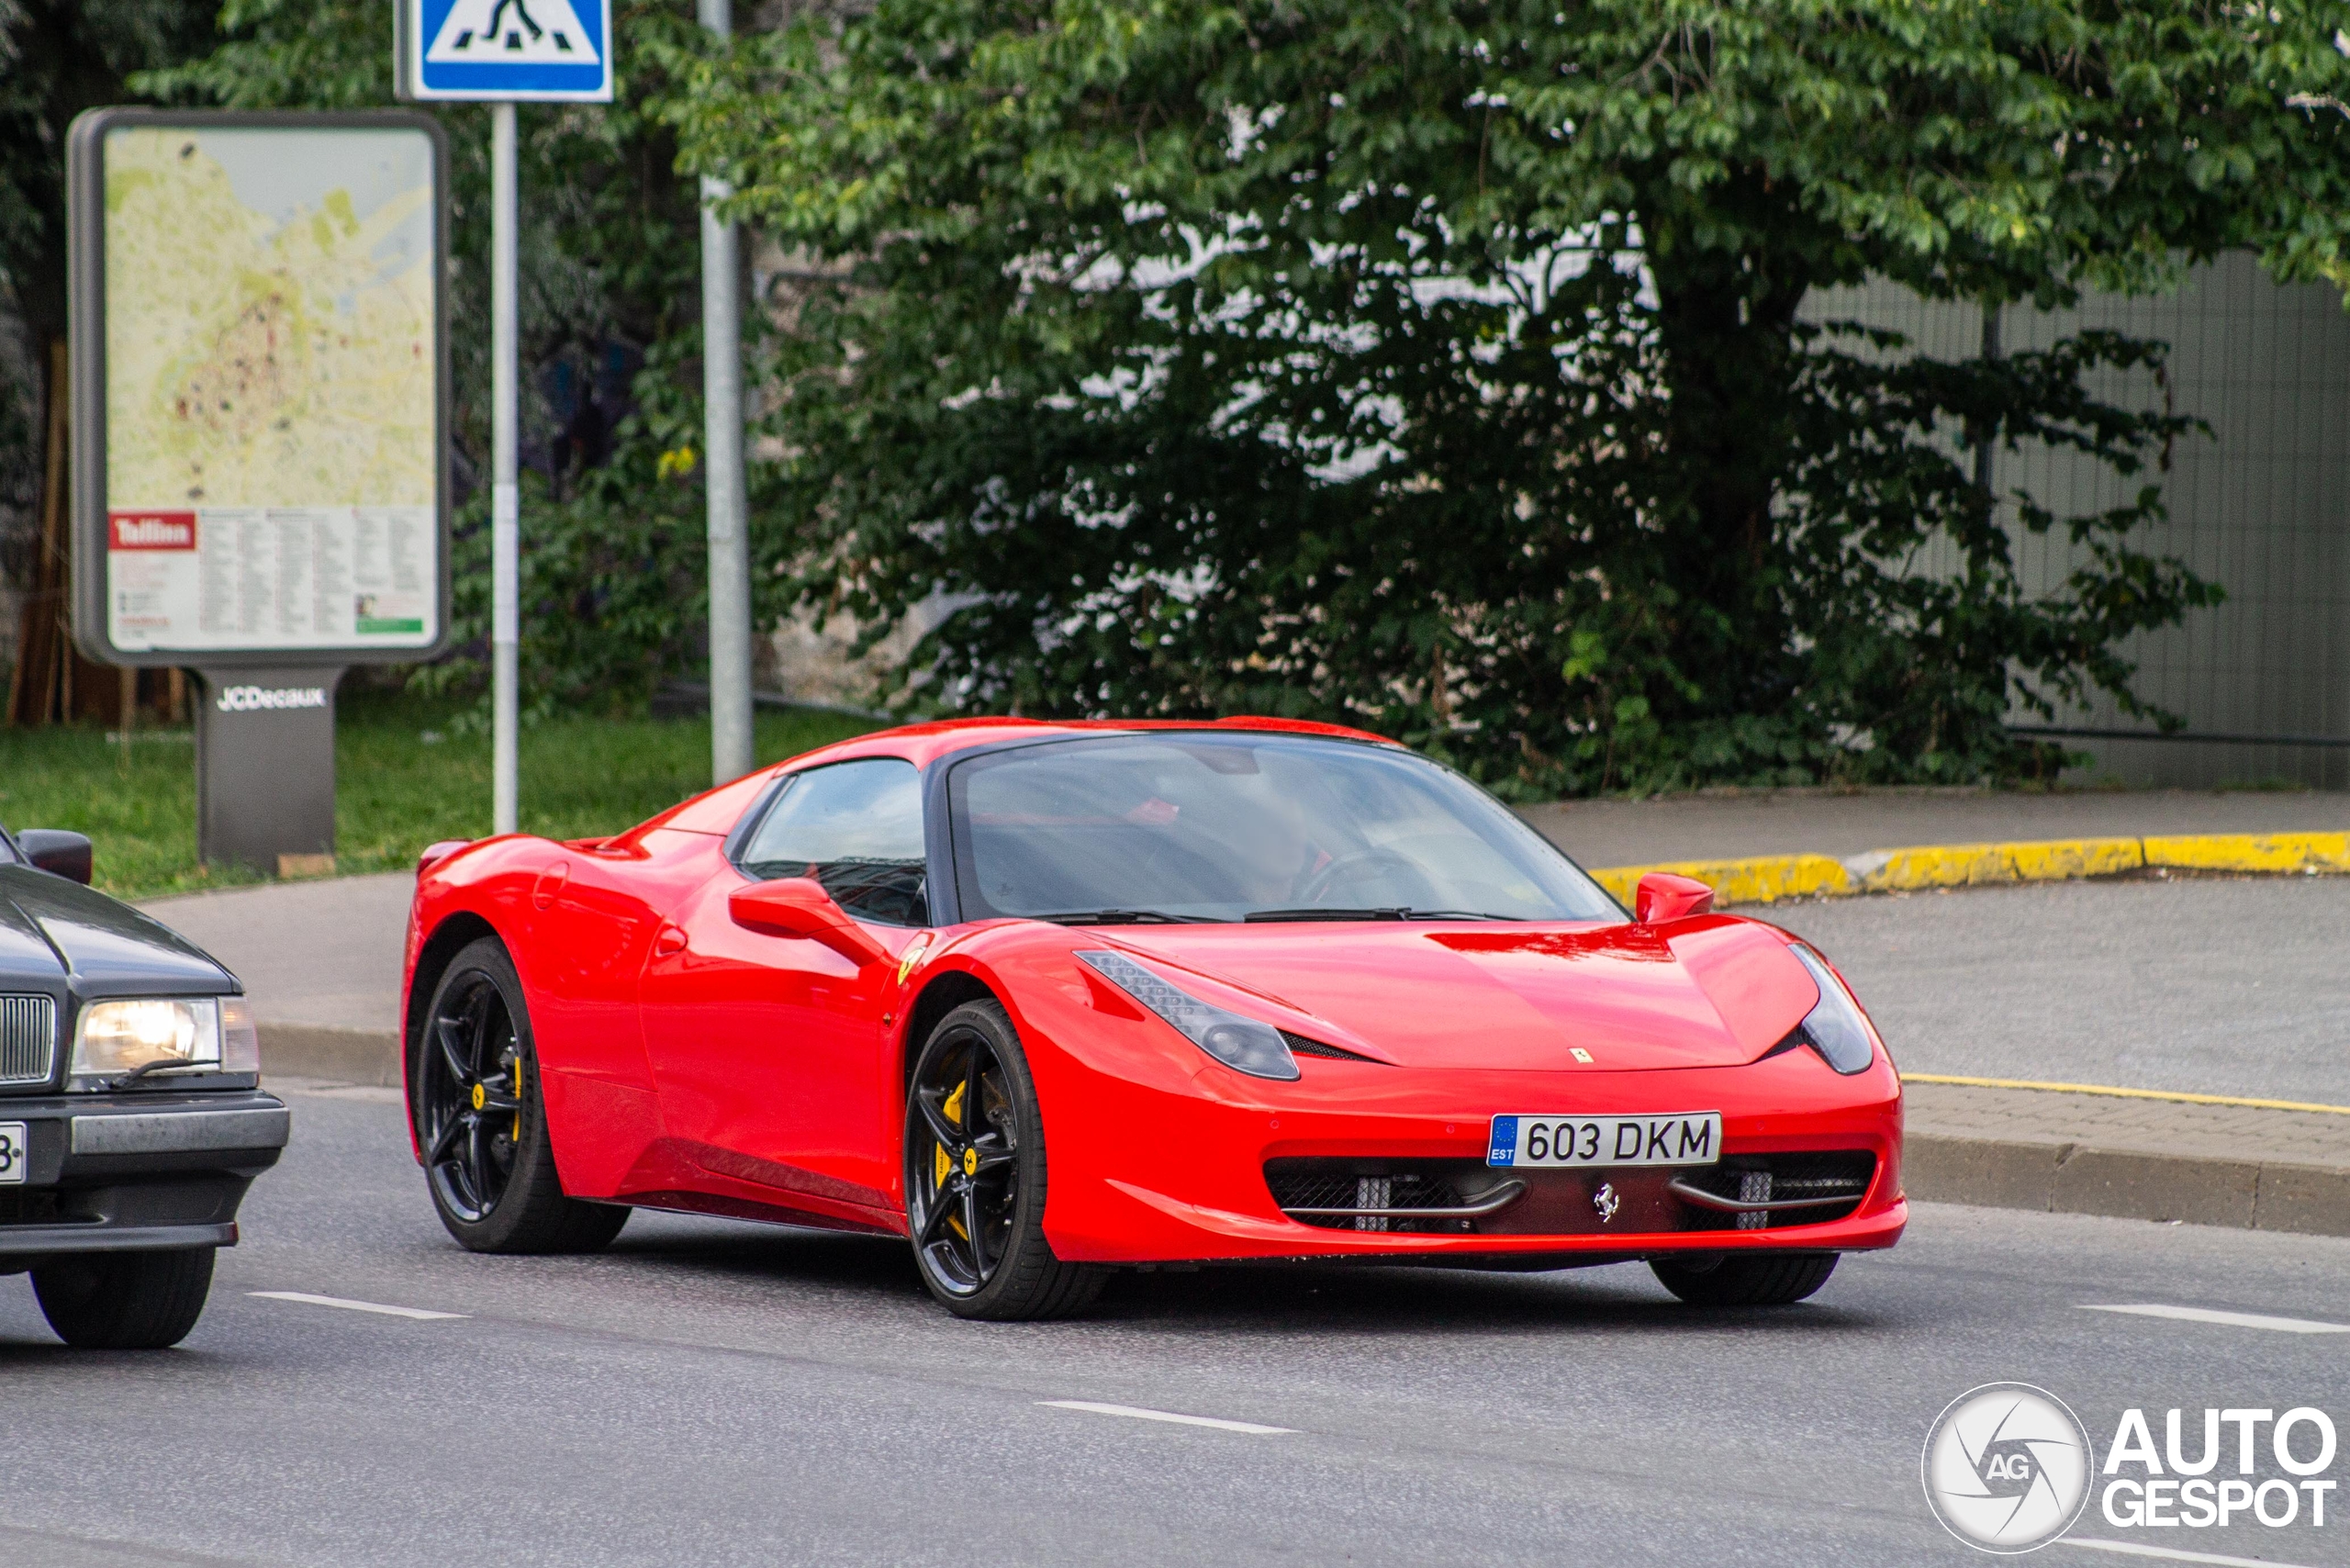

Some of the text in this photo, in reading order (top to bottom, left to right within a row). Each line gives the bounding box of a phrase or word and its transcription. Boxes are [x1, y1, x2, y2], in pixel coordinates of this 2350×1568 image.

[115, 518, 191, 545] Tallinn
[217, 686, 327, 711] JCDecaux
[1527, 1119, 1710, 1160] 603 DKM
[1491, 1148, 1515, 1160] EST
